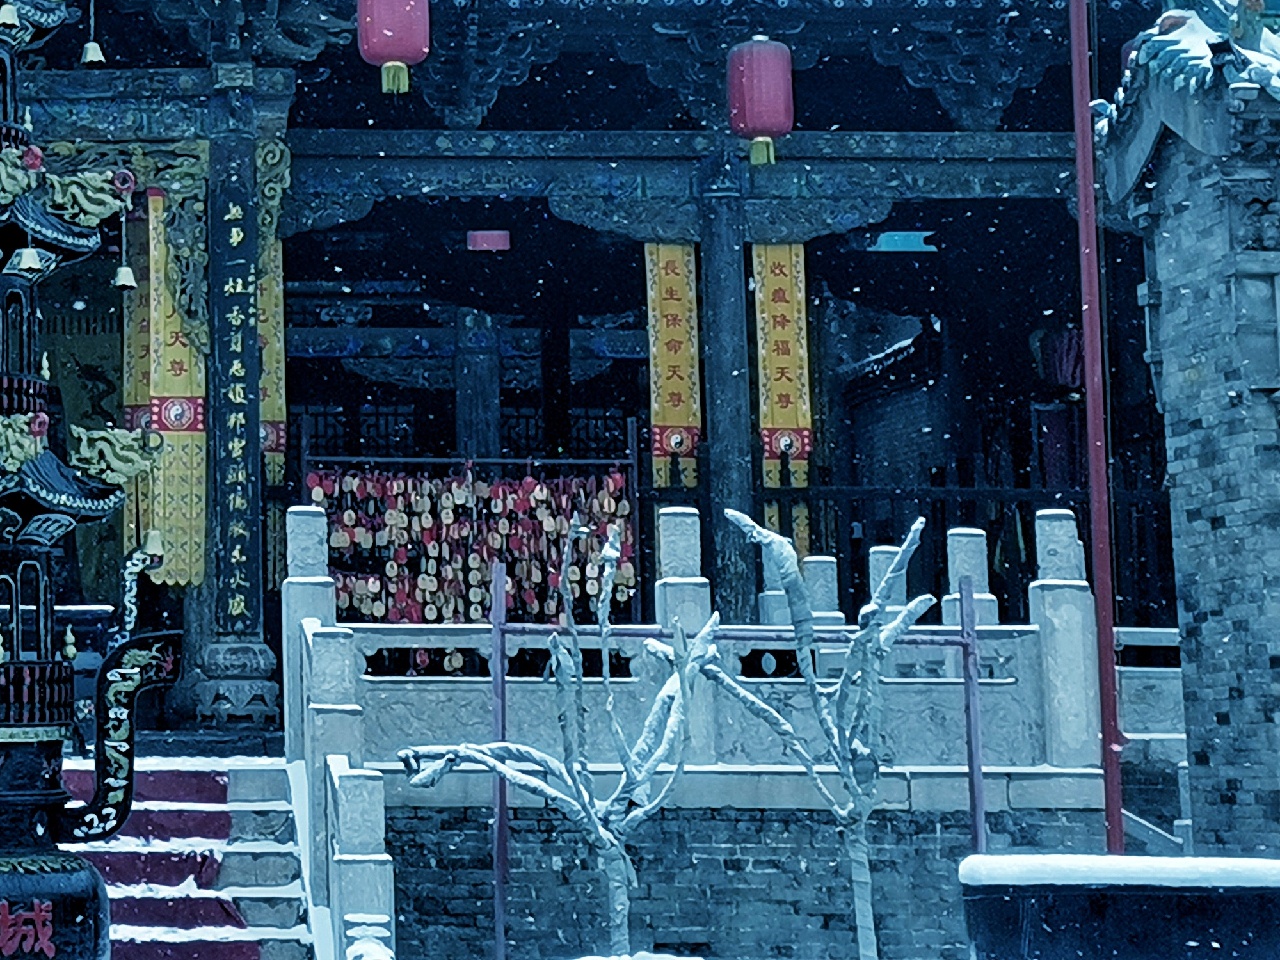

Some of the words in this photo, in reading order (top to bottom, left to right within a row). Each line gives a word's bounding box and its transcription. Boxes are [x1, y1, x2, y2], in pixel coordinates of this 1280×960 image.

[662, 260, 685, 408] 長生保命天尊
